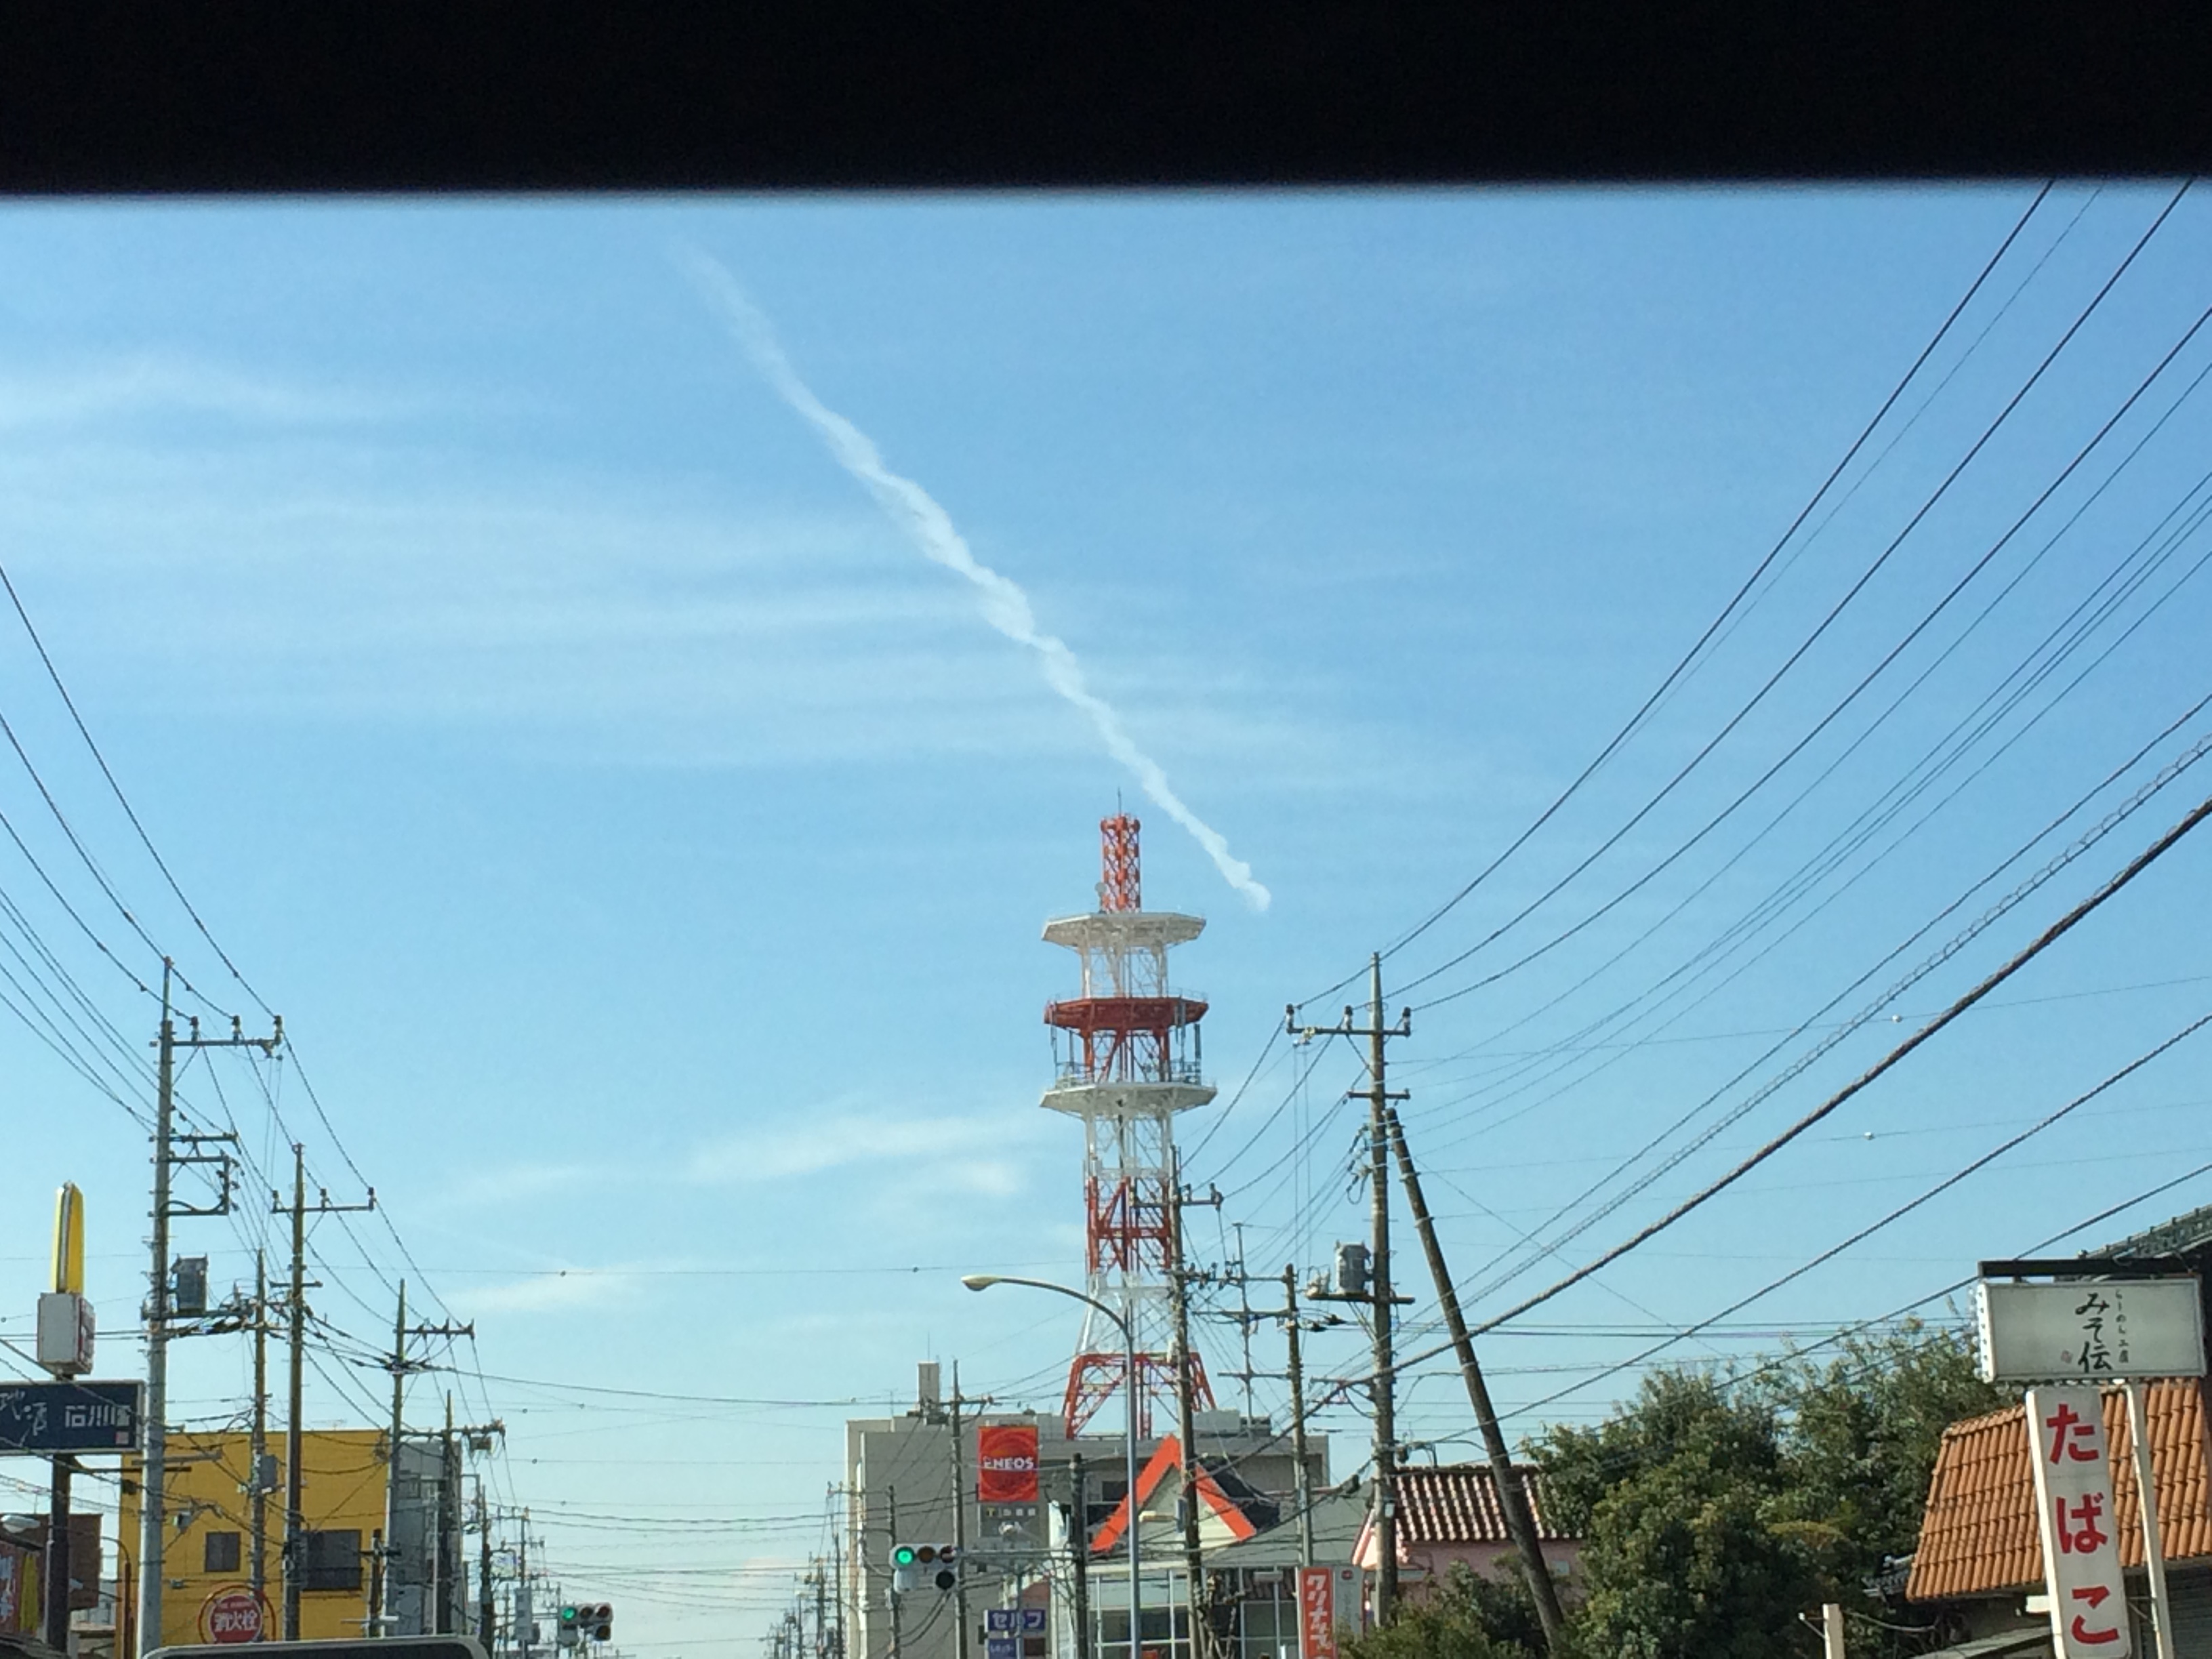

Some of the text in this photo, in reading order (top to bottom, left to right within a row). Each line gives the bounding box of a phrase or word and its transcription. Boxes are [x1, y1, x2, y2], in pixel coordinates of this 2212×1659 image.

[2075, 1292, 2112, 1374] みそ伝
[984, 1456, 1034, 1469] ENEOS
[2046, 1403, 2119, 1645] たばこ
[214, 1610, 259, 1633] 消火栓
